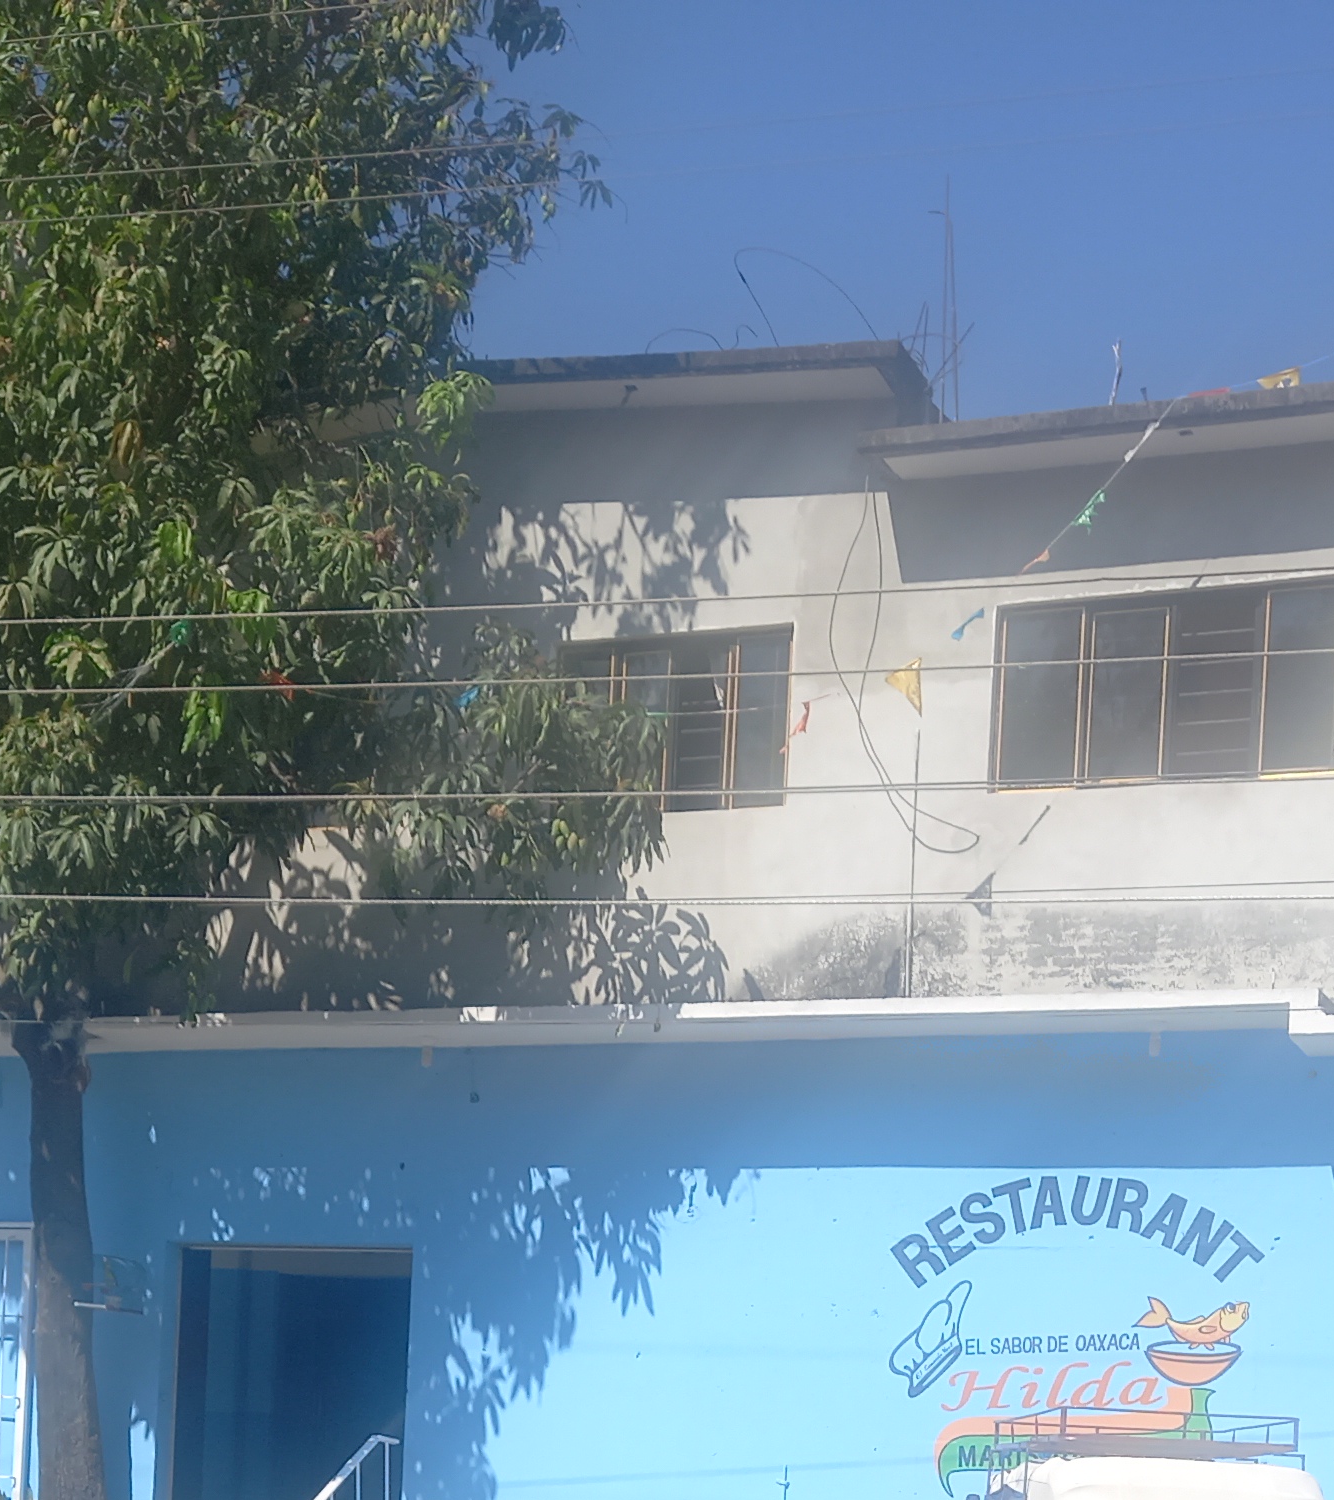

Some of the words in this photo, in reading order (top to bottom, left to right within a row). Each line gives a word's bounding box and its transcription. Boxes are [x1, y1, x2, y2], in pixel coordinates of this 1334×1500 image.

[889, 1175, 1266, 1288] RESTAURANT
[965, 1337, 987, 1356] EL
[990, 1336, 1043, 1355] SABOR
[1046, 1335, 1069, 1353] DE
[1075, 1333, 1141, 1352] OAXACA
[940, 1360, 1165, 1412] Hilda
